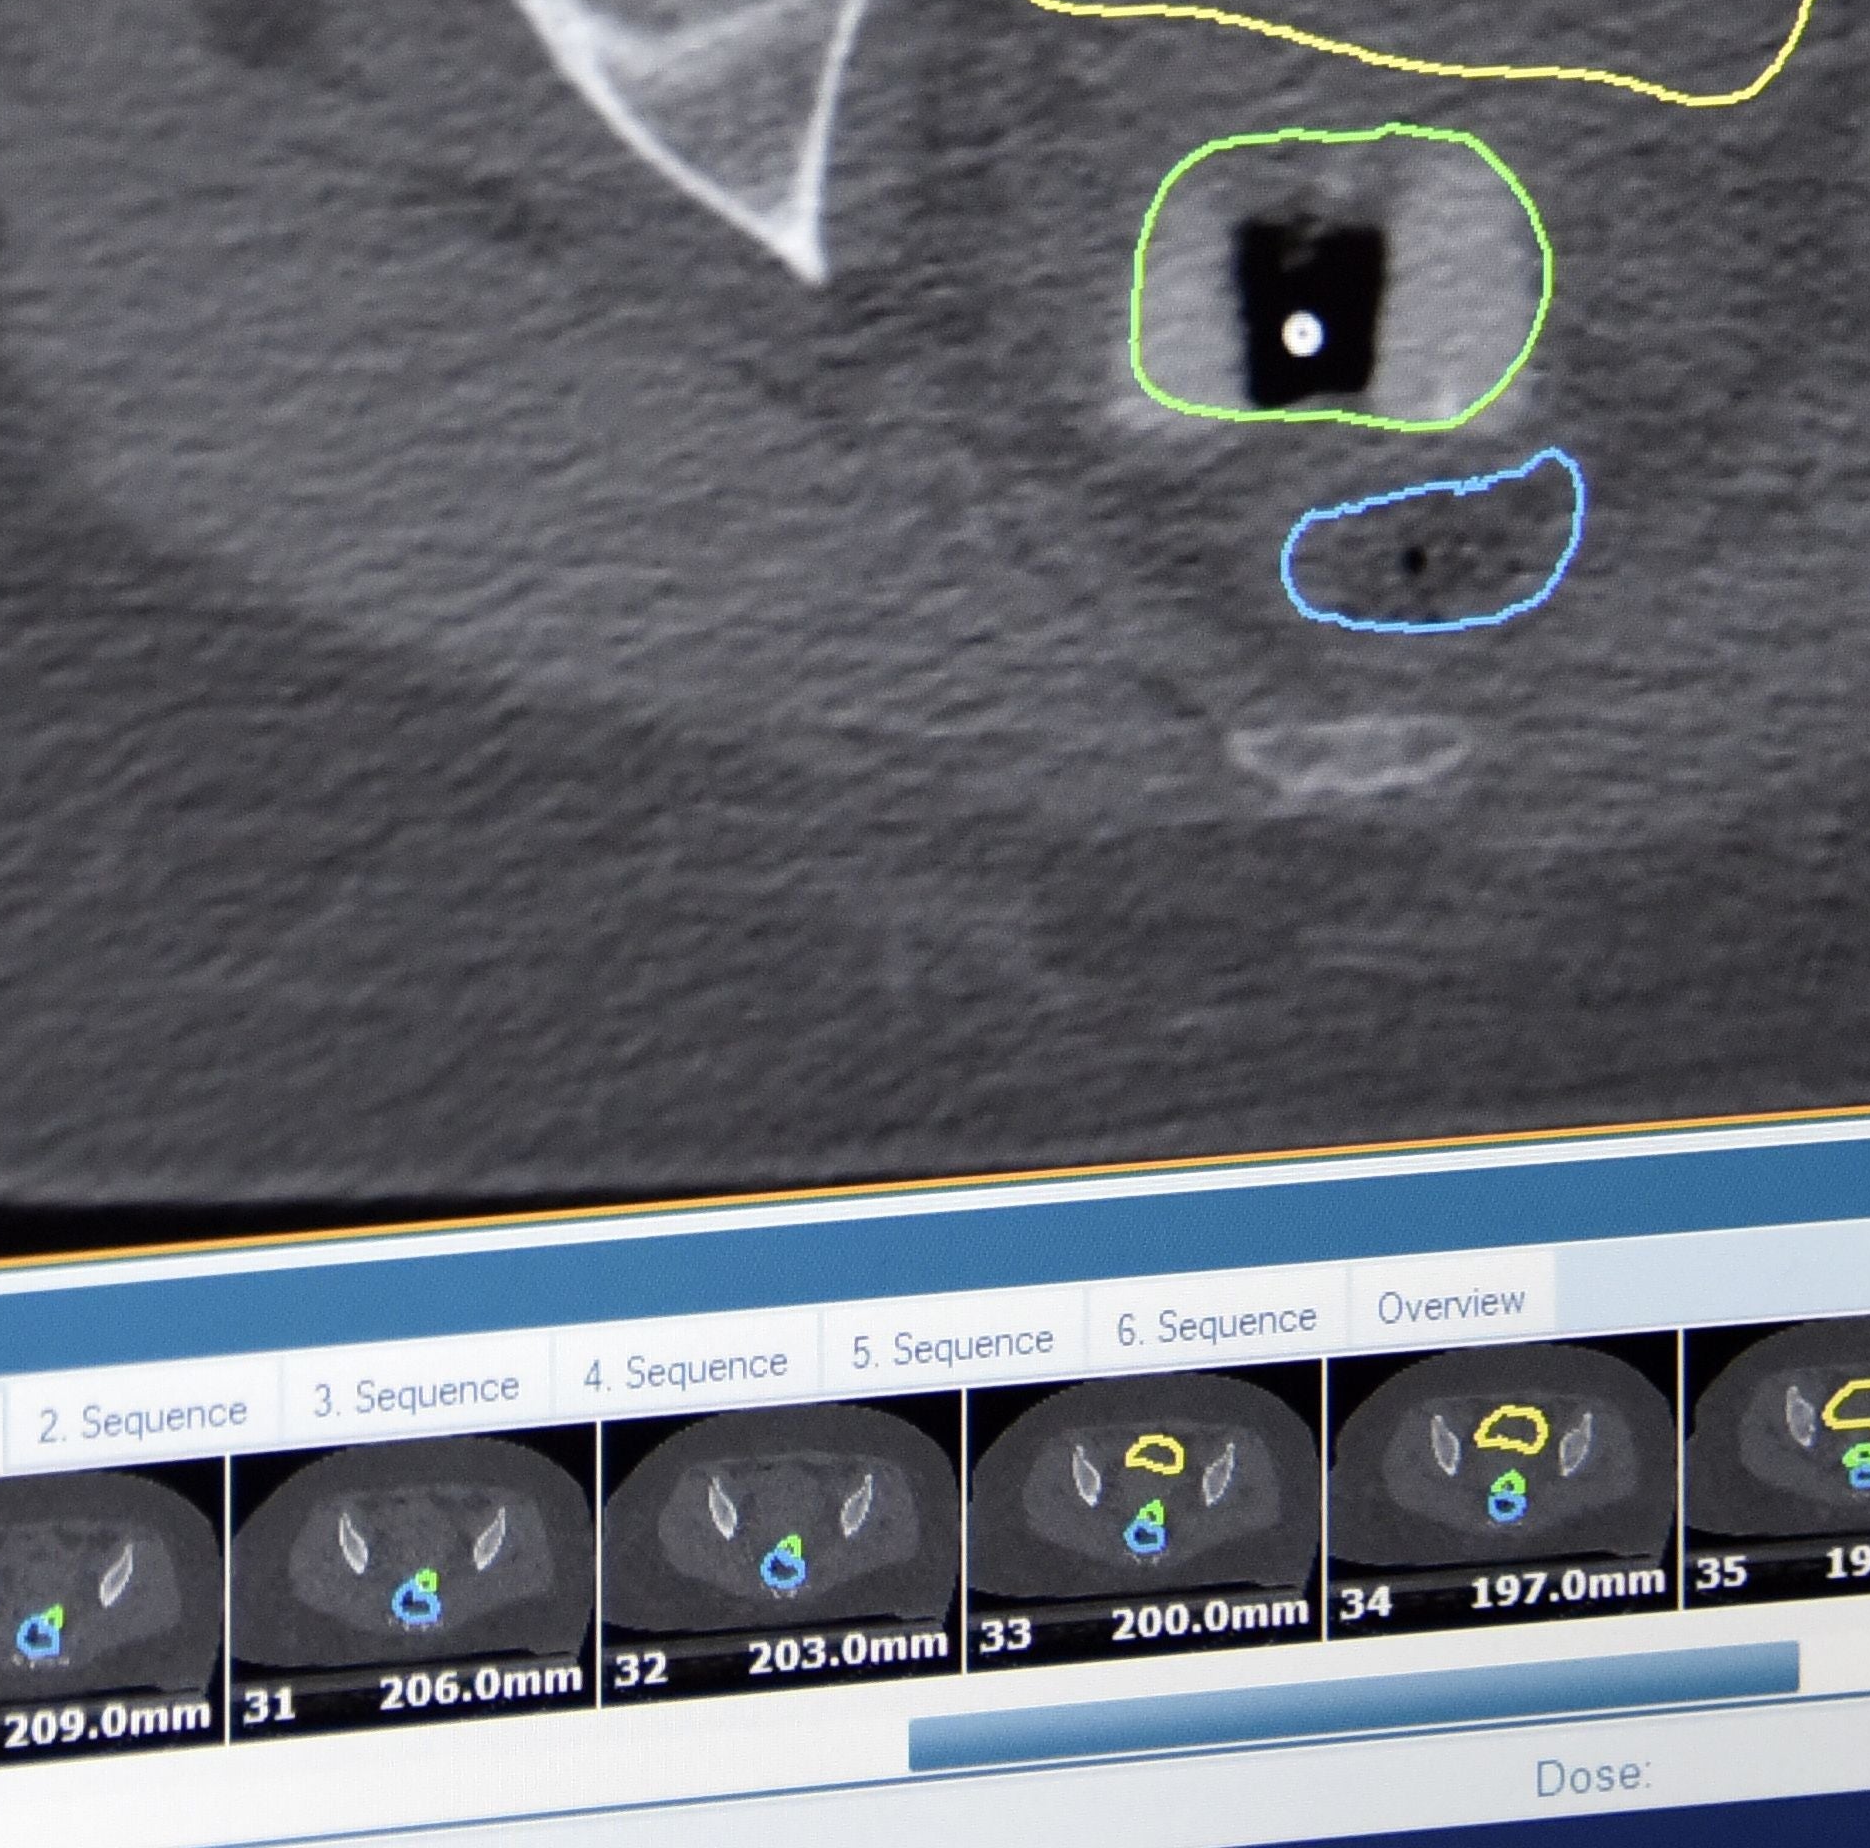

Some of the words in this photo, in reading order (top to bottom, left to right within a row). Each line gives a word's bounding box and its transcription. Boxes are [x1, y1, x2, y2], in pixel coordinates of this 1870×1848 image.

[1116, 1313, 1145, 1347] 6.
[1157, 1302, 1318, 1346] Sequence
[1376, 1285, 1526, 1327] Overview
[852, 1334, 880, 1371] 5.
[893, 1325, 1054, 1371] Sequence
[583, 1359, 613, 1394] 4.
[625, 1350, 789, 1392] Sequence
[313, 1382, 342, 1419] 3.
[355, 1374, 521, 1416] Sequence
[38, 1409, 68, 1445] 2.
[81, 1395, 249, 1442] Sequence
[1339, 1585, 1393, 1623] 34
[1470, 1564, 1666, 1611] 197.0mm
[1695, 1554, 1748, 1593] 35
[979, 1616, 1033, 1655] 33
[1110, 1597, 1310, 1644] 200.0mm
[613, 1651, 669, 1690] 32
[747, 1630, 949, 1677] 203.0mm
[242, 1686, 296, 1727] 31
[379, 1662, 584, 1712] 206.0mm
[3, 1698, 213, 1750] 209.0mm
[1535, 1756, 1653, 1800] Dose:
